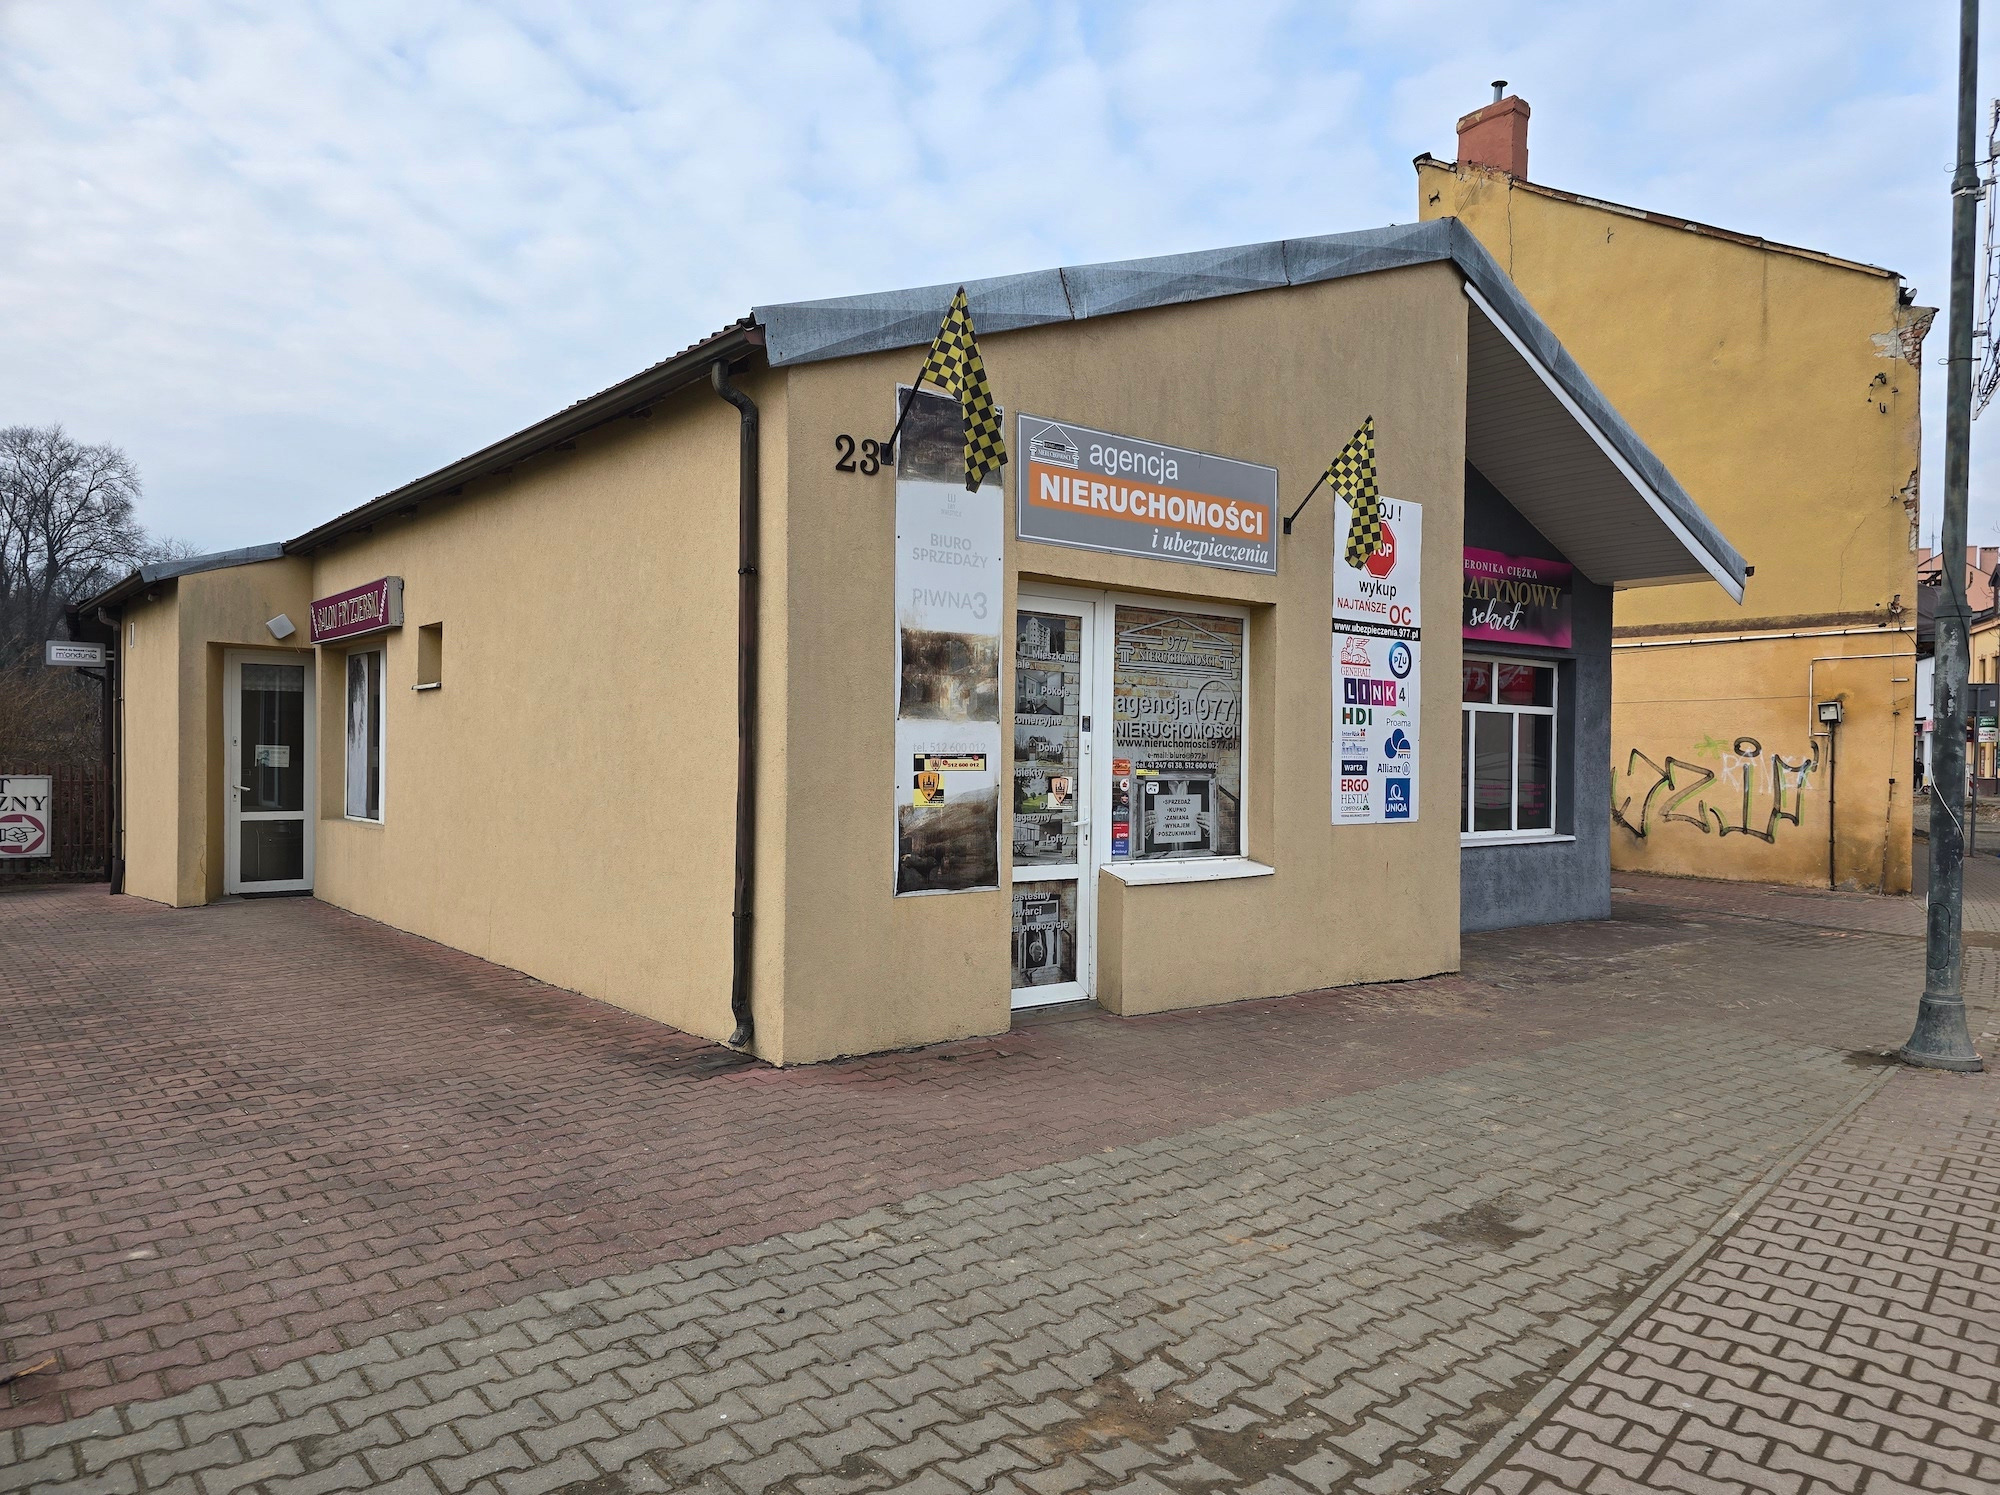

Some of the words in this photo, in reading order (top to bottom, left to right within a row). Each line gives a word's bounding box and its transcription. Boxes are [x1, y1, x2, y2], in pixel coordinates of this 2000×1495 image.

[835, 434, 880, 476] 23
[1089, 444, 1178, 484] agencja
[1040, 473, 1263, 535] NIERUCHOMOŚCI
[930, 533, 972, 551] BIURO
[1152, 528, 1159, 548] i
[1163, 532, 1269, 564] ubezpieczenia
[912, 547, 988, 569] SPRZEDAŻY
[1464, 559, 1504, 574] ERONIKA
[1507, 566, 1538, 579] CIĘŻKA
[1359, 580, 1397, 600] wykup
[317, 604, 337, 632] SALON
[338, 590, 379, 628] FRYZJERSKI
[1337, 597, 1387, 614] NAJTAŃSZE
[1389, 605, 1412, 625] OC
[1470, 598, 1524, 631] sekret
[1333, 622, 1419, 639] www.ubezpieczenia.977.pl
[1167, 636, 1189, 652] 977
[1032, 649, 1080, 663] Mieszkania
[1138, 651, 1217, 667] NIERUCHOMOŚCI
[1394, 653, 1407, 669] PZU
[1016, 660, 1031, 669] ale
[1341, 667, 1371, 677] GENERALI
[1041, 686, 1070, 698] Pokoje
[1346, 682, 1395, 702] LINK
[1398, 687, 1406, 702] 4
[1114, 692, 1192, 720] agencja
[1199, 698, 1235, 722] 977
[1342, 707, 1373, 726] HDI
[1387, 718, 1412, 727] Proama
[1114, 721, 1237, 740] NIERUCHOMOŚCI
[913, 742, 927, 753] tel.
[930, 743, 947, 753] 512
[950, 743, 967, 753] 600
[969, 743, 986, 753] 012
[1039, 743, 1063, 754] Domy
[1117, 739, 1236, 752] www.nieruchomosci.977.pl
[1155, 761, 1167, 769] 247
[1377, 763, 1401, 773] Allianz
[1015, 767, 1044, 780] biekty
[1341, 779, 1369, 792] ERGO
[1341, 793, 1369, 804] HESTIA
[1385, 803, 1408, 812] UNIQA
[1046, 833, 1069, 845] Lofty
[1013, 890, 1051, 902] esteśmy
[1013, 905, 1043, 918] twarci
[1021, 920, 1069, 934] propozycje
